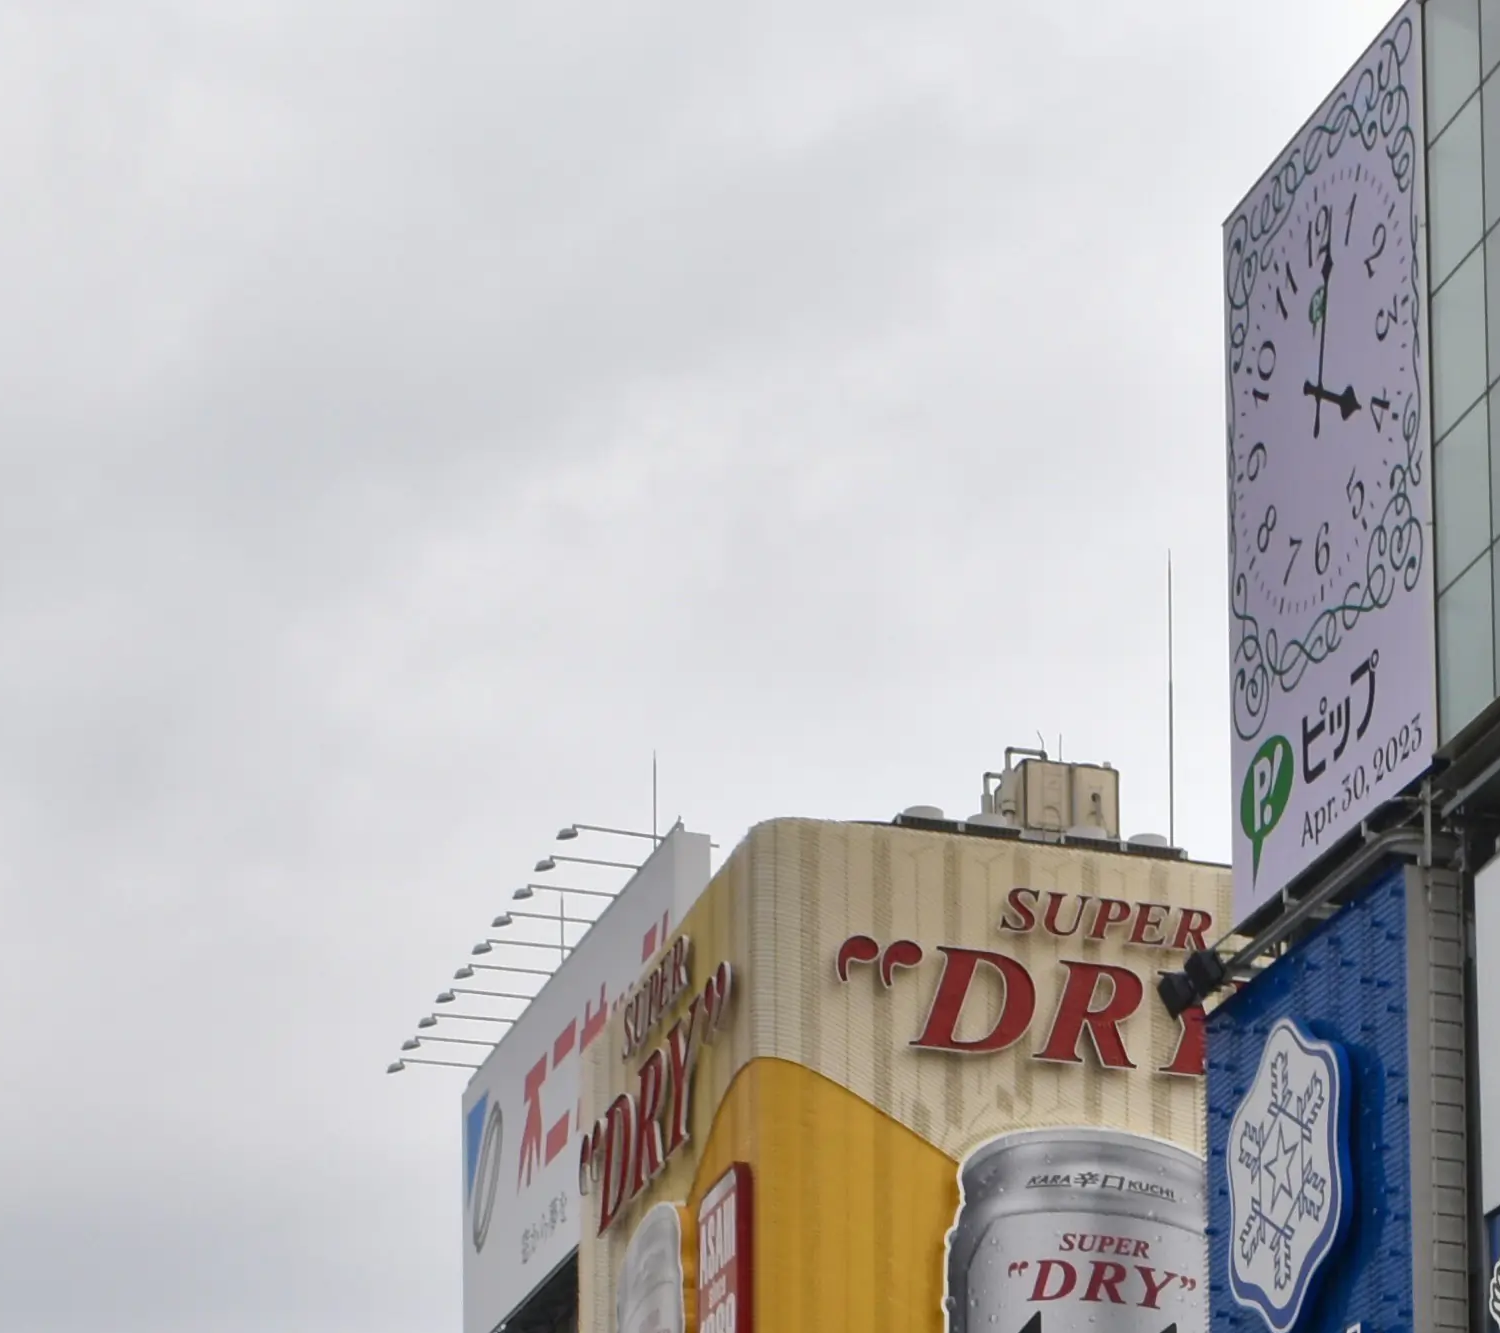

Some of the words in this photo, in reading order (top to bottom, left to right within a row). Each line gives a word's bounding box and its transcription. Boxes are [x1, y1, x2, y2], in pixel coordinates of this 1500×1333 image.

[1365, 223, 1388, 278] 2
[1375, 300, 1398, 341] 3
[1370, 393, 1391, 433] 4
[1347, 466, 1365, 520] 5
[1256, 504, 1277, 553] 8
[1313, 522, 1331, 576] 6
[1284, 538, 1303, 587] 7
[1301, 647, 1380, 786] ピップ
[1301, 795, 1339, 850] Apr.
[1342, 757, 1372, 816] 30,
[1373, 714, 1423, 780] 2023
[1000, 886, 1214, 950] SUPER
[622, 934, 690, 1062] SUPER
[1058, 1232, 1151, 1260] SUPER
